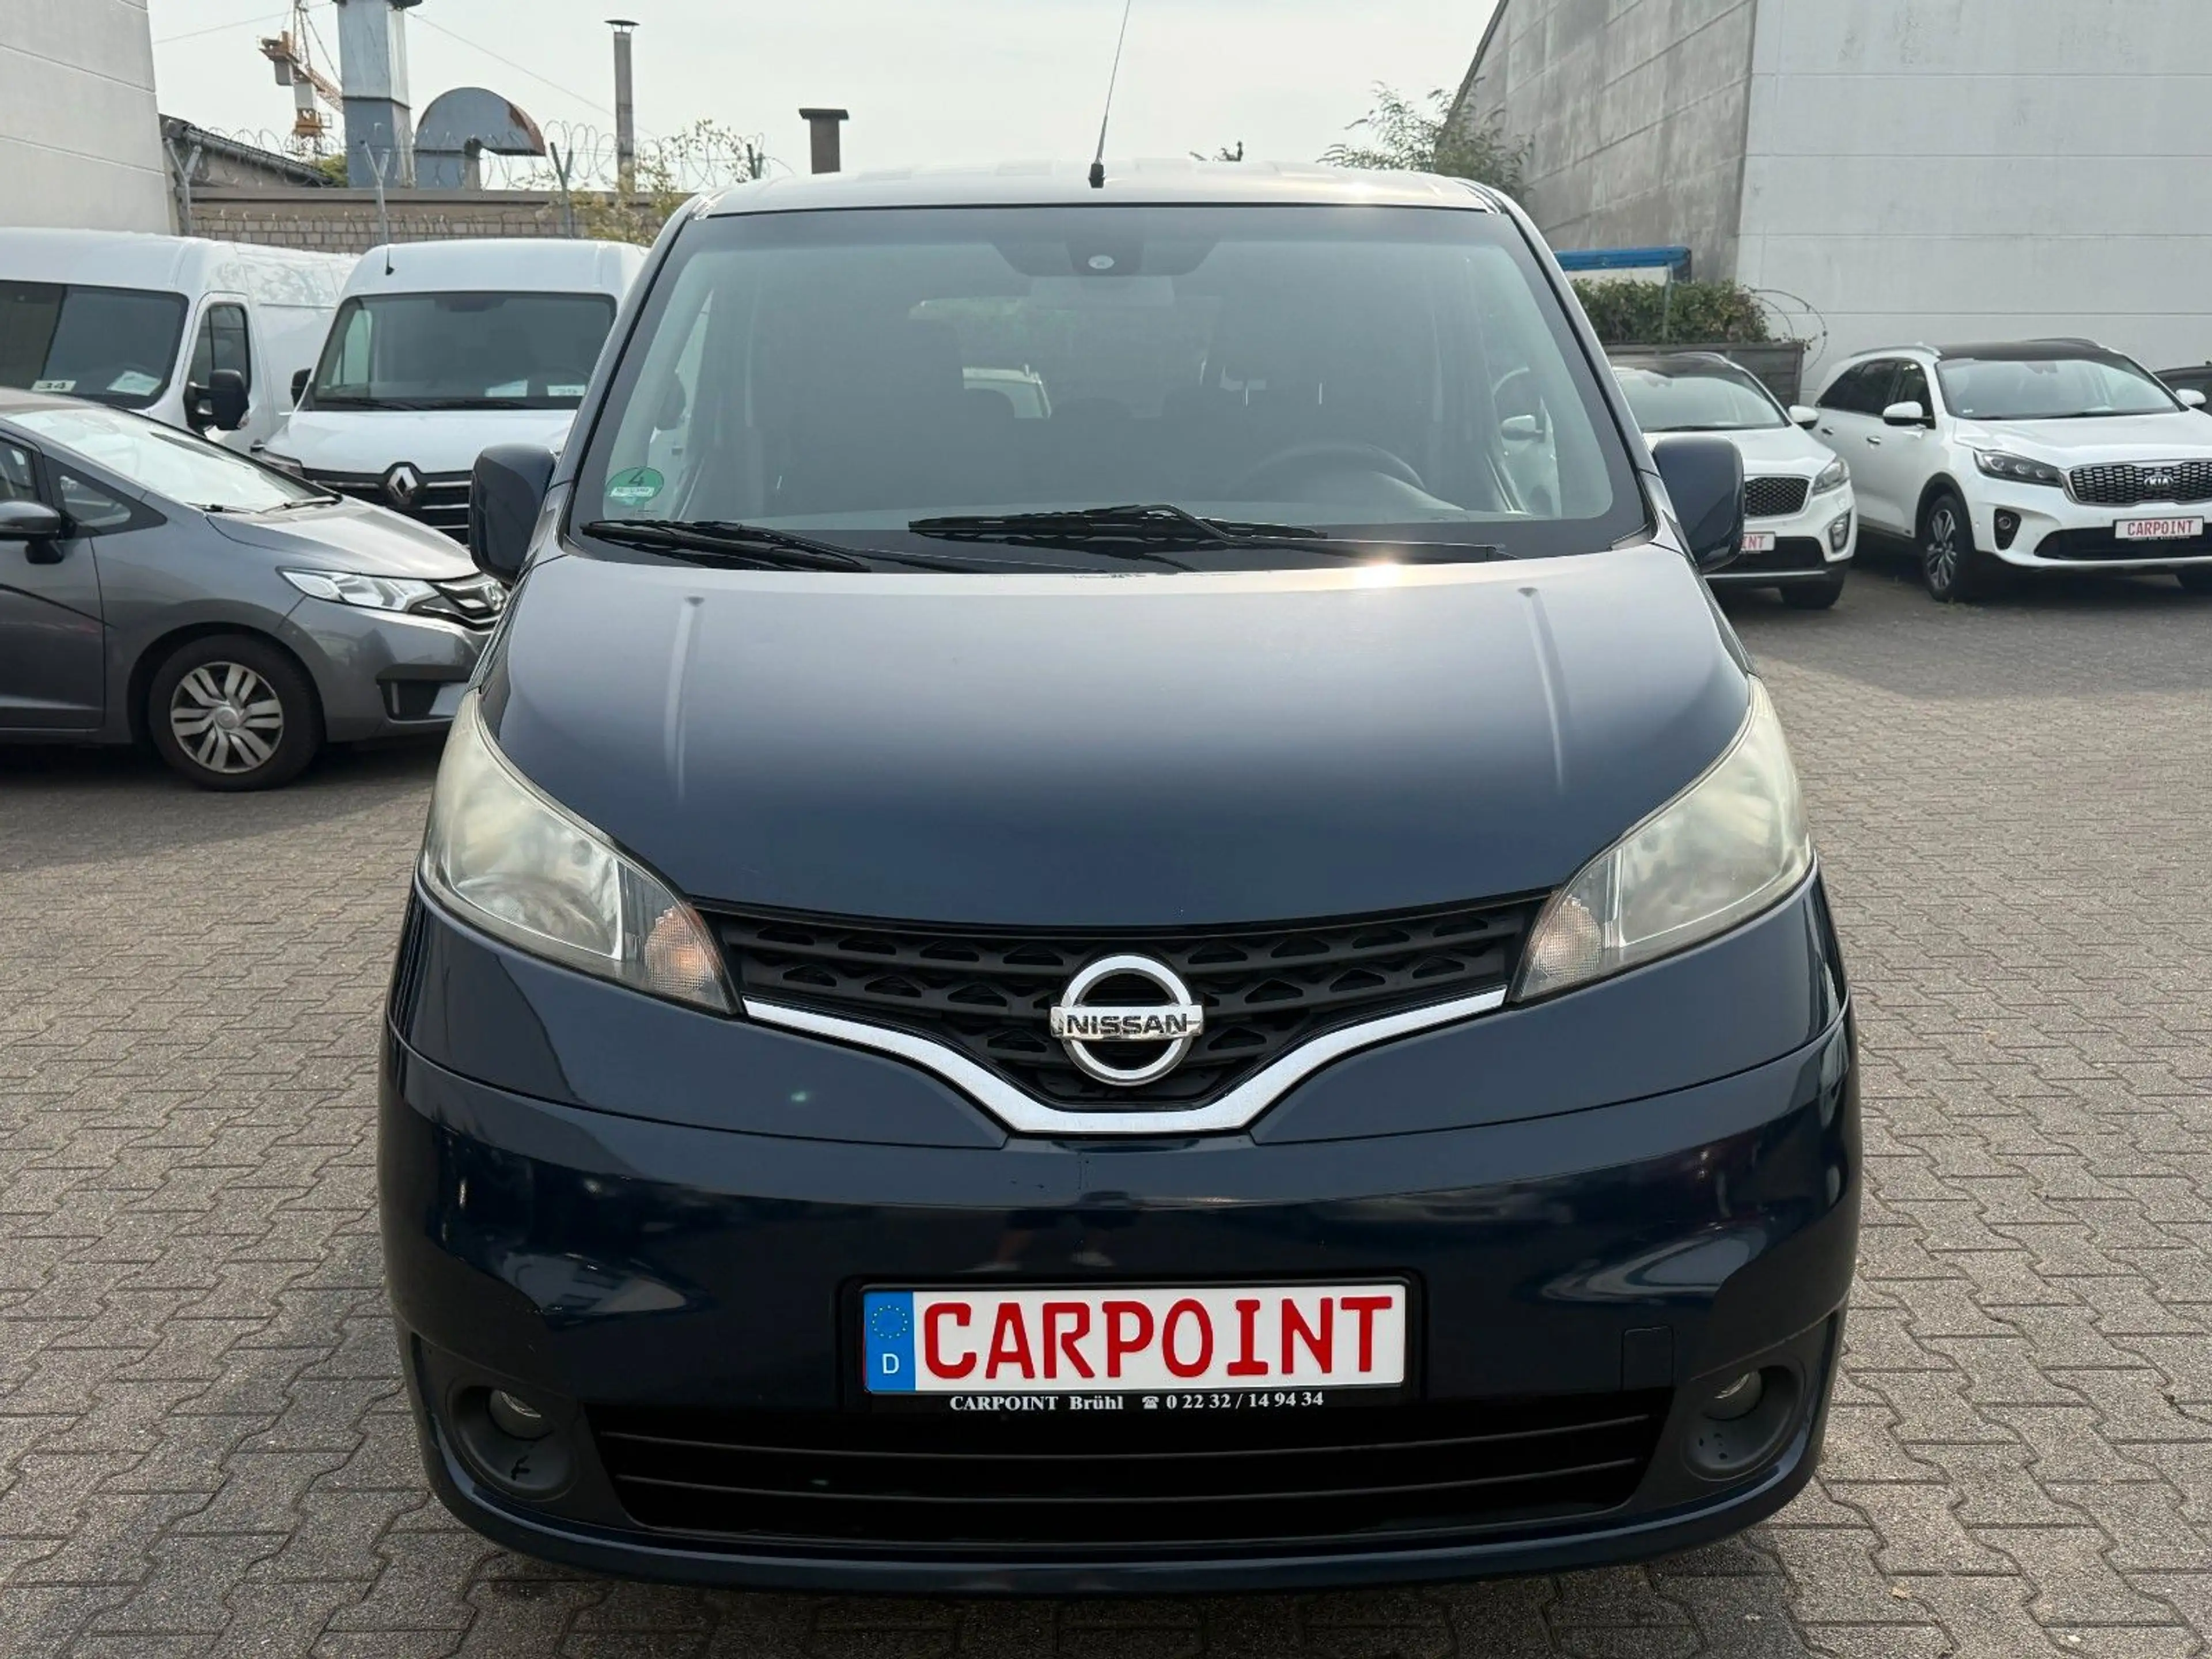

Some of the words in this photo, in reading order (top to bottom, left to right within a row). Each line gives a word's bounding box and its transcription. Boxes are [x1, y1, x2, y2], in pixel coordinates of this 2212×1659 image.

[628, 470, 644, 486] 4
[2127, 520, 2194, 536] CARPOINT
[1066, 1013, 1188, 1035] NISSAN
[923, 1296, 1393, 1379] CARPOINT
[881, 1353, 900, 1374] D
[949, 1396, 1059, 1411] CARPOINT
[1070, 1395, 1123, 1410] Brühl
[1166, 1395, 1177, 1410] 0
[1183, 1394, 1205, 1409] 22
[1210, 1393, 1232, 1408] 32
[1249, 1393, 1270, 1408] 14
[1274, 1392, 1297, 1407] 94
[1301, 1391, 1324, 1407] 34
